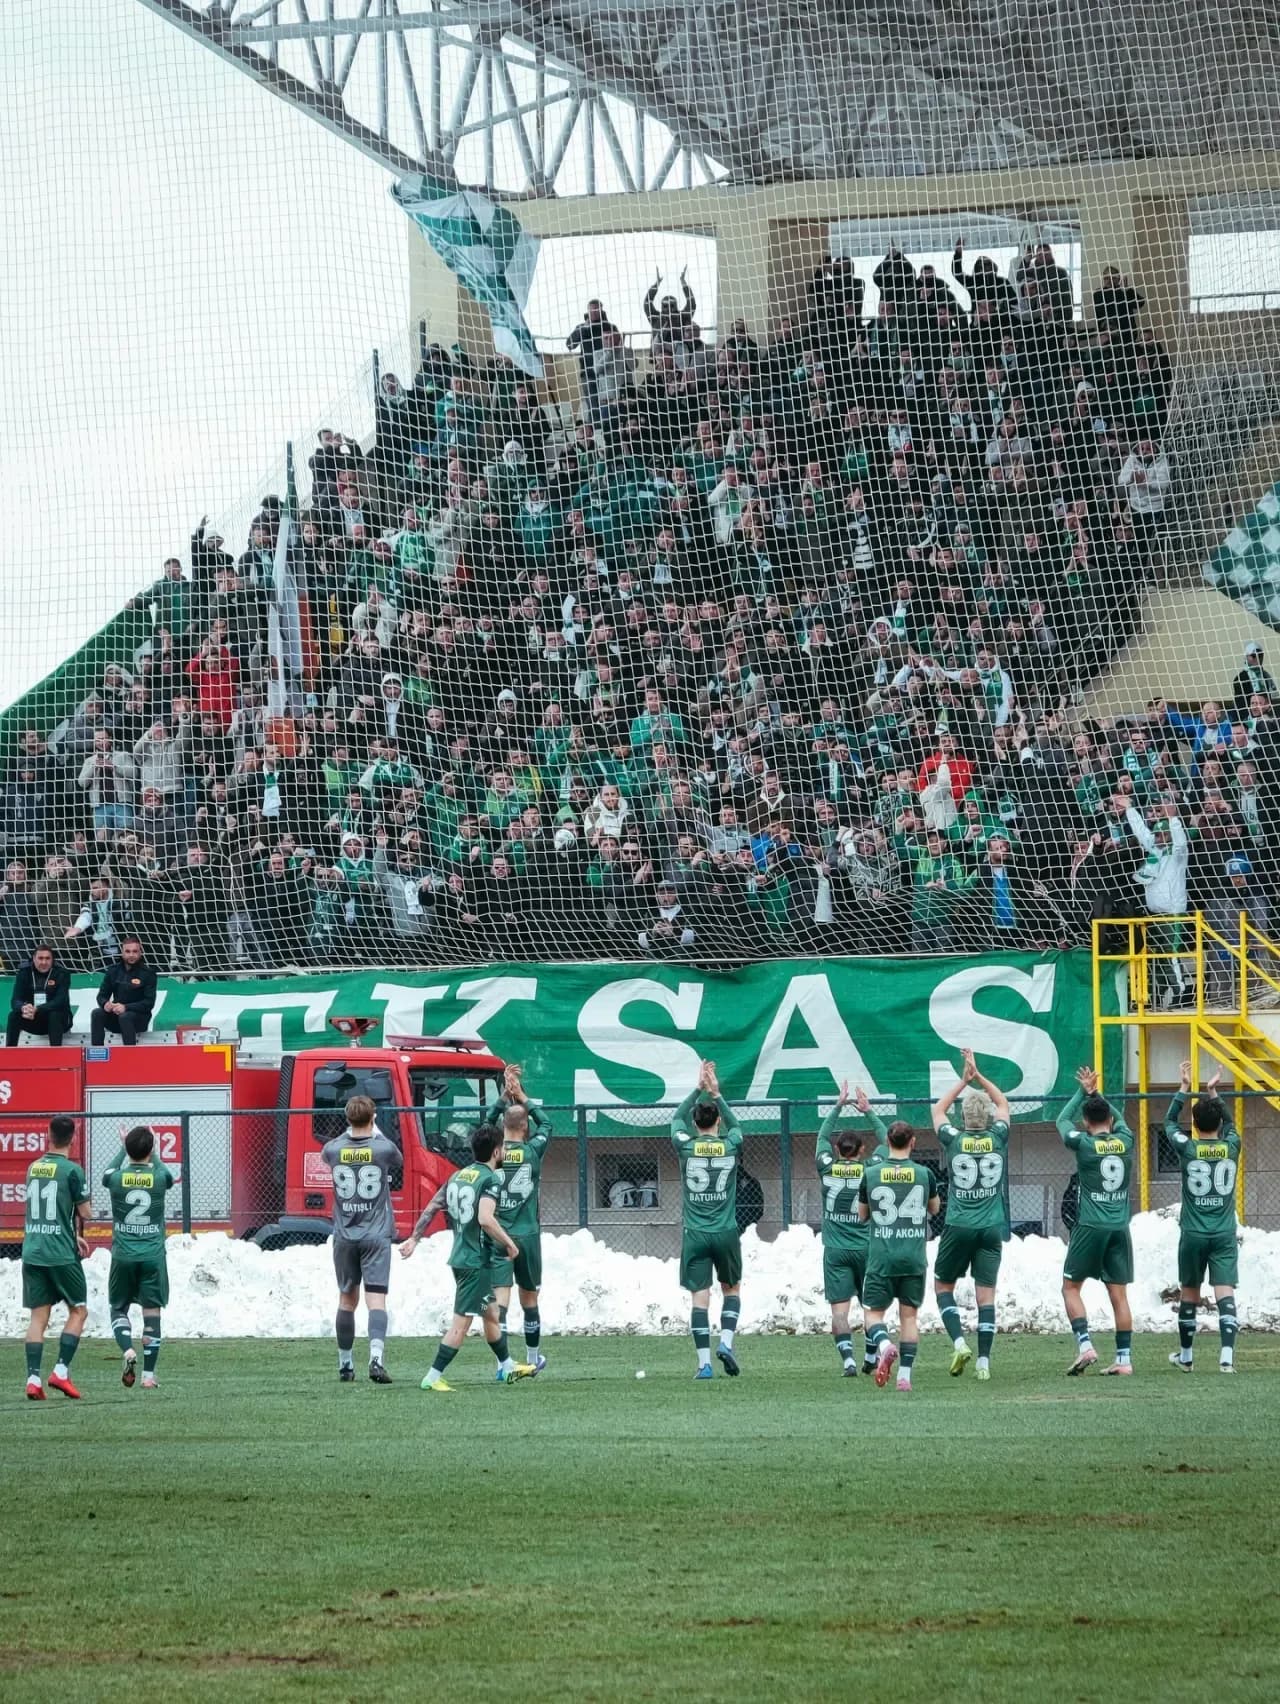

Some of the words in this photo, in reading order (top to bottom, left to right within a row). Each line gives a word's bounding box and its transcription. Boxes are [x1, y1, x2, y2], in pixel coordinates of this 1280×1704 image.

[333, 1165, 382, 1199] 98
[686, 1156, 735, 1192] 57
[952, 1153, 1003, 1190] 99
[1100, 1155, 1125, 1191] 9
[1187, 1159, 1236, 1198] 80
[27, 1179, 58, 1221] 11
[124, 1190, 151, 1225] 2
[823, 1176, 861, 1213] 77
[871, 1185, 927, 1225] 34
